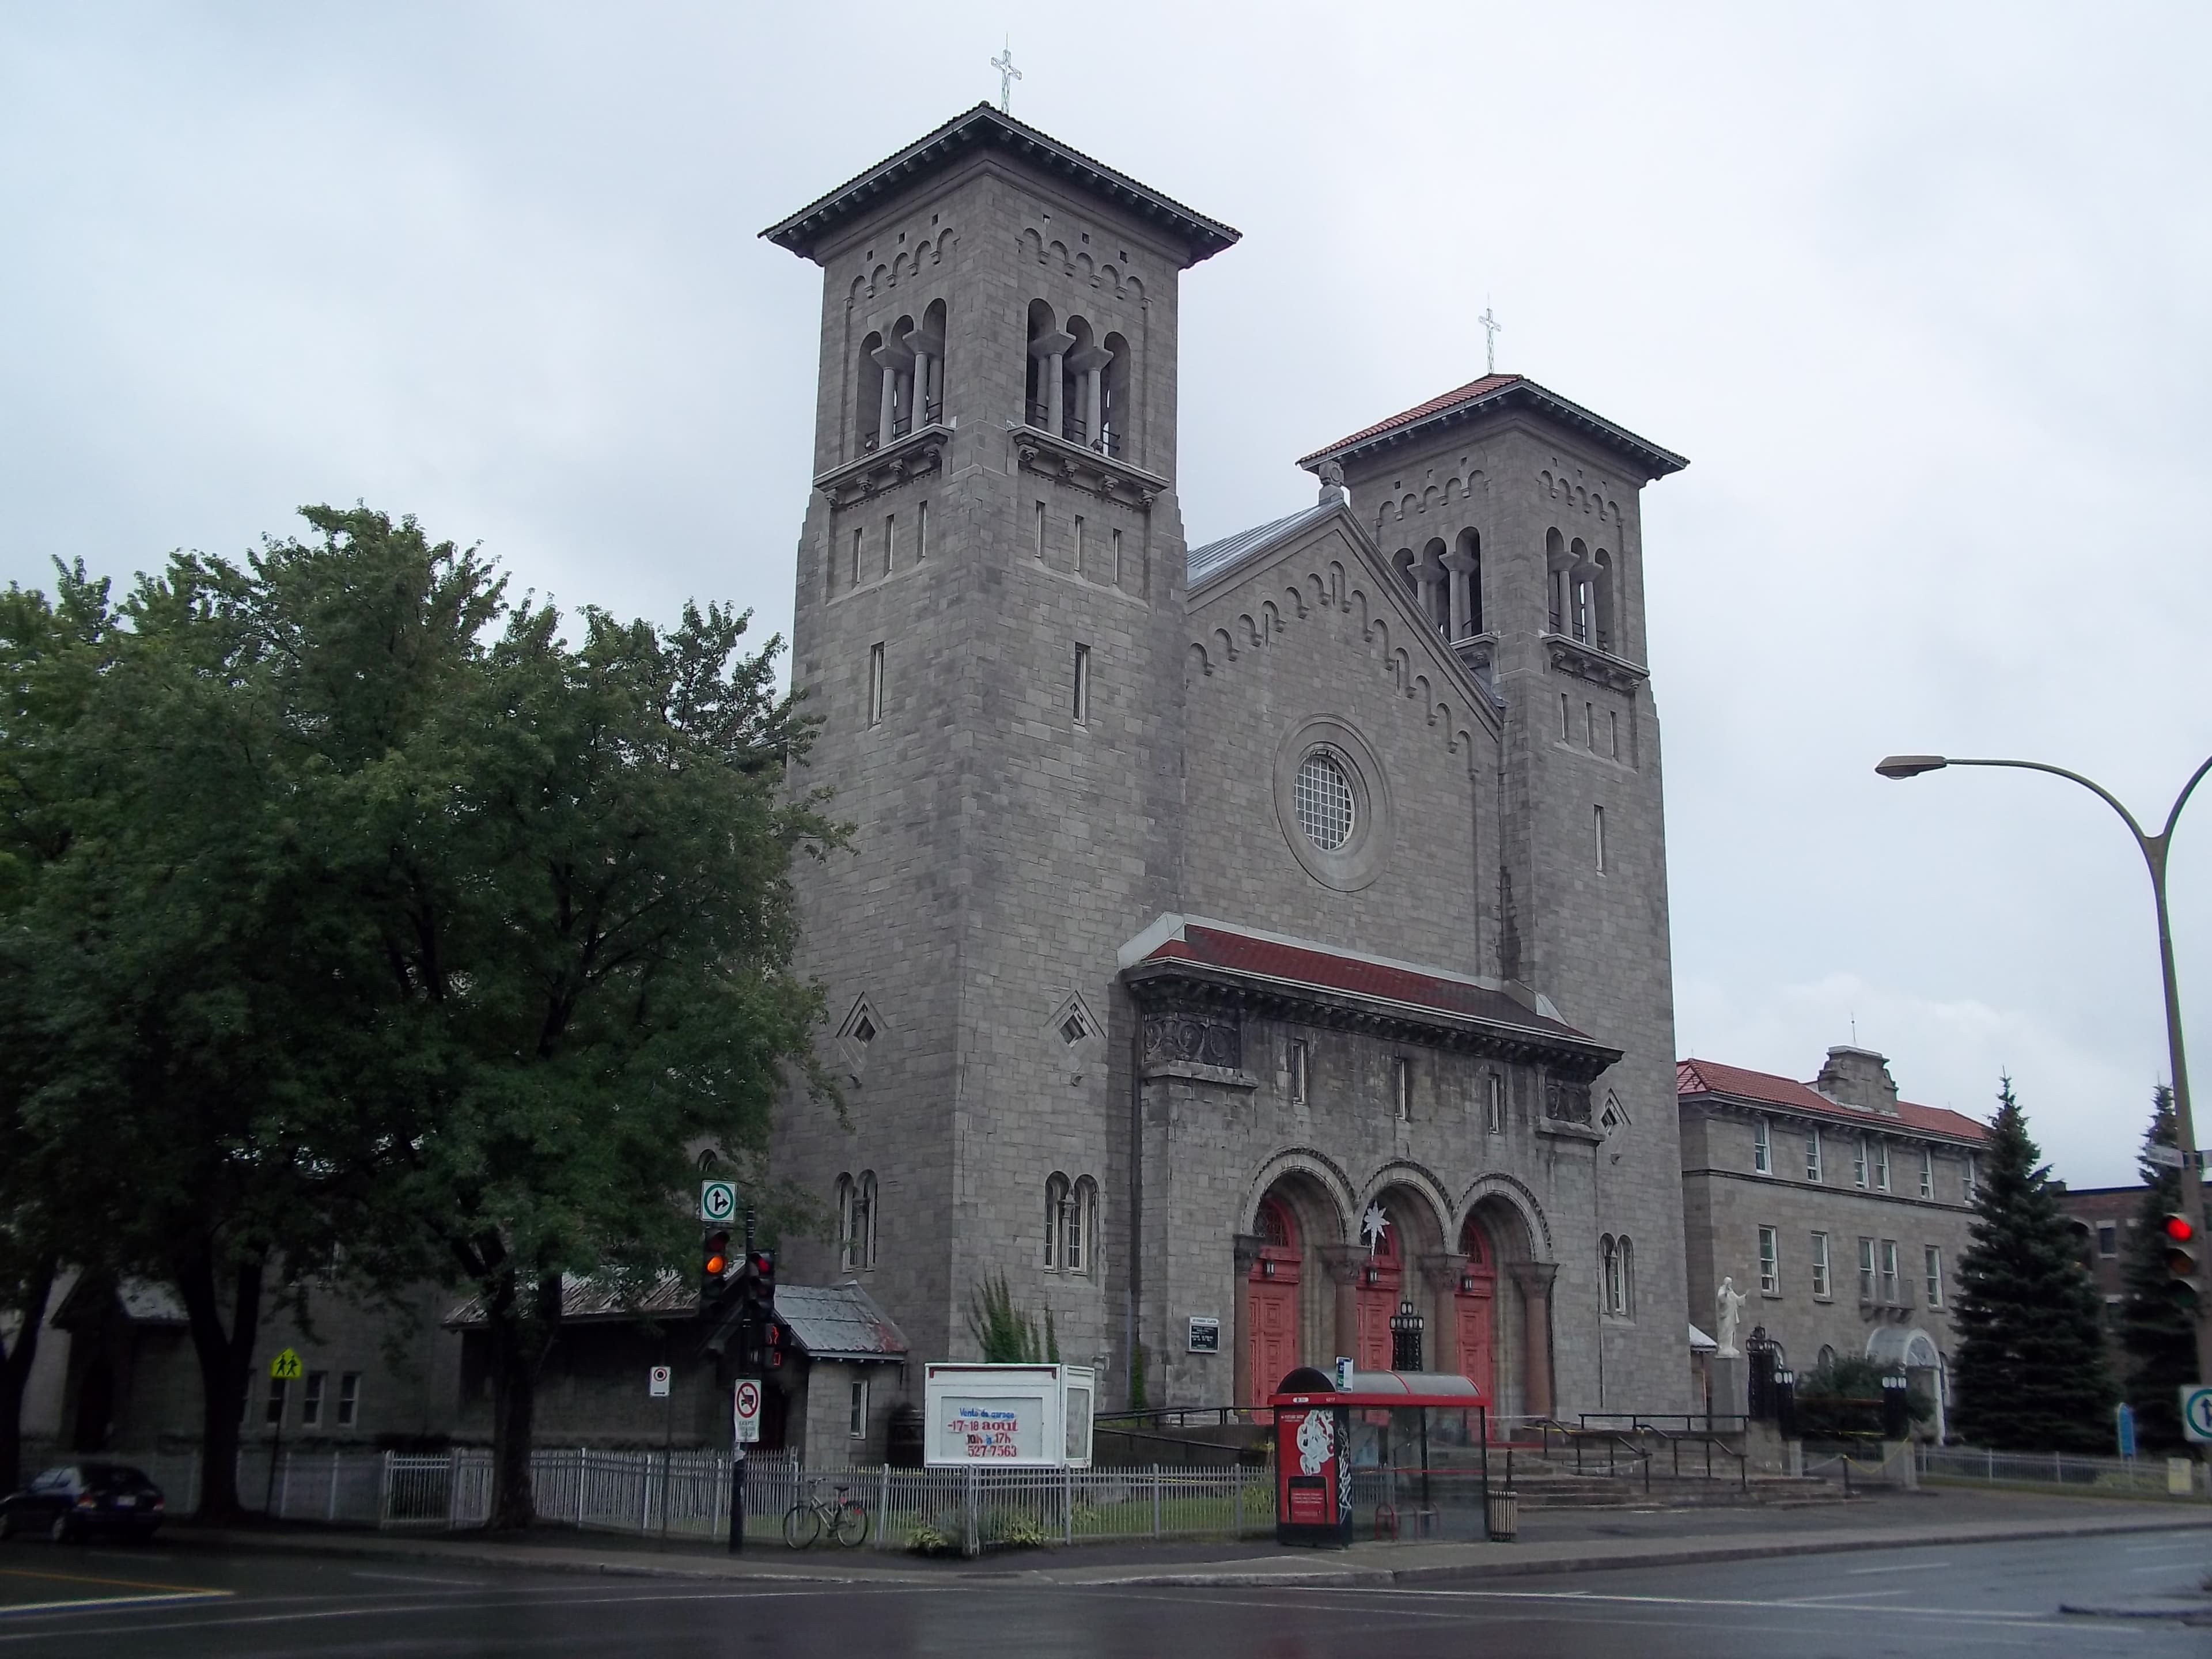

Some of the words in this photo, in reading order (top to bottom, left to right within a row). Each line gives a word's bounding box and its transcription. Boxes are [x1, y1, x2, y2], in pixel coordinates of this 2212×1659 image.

[959, 1408, 978, 1417] Vente
[980, 1409, 989, 1417] de
[967, 1434, 983, 1444] 10h
[995, 1433, 1011, 1444] 17h
